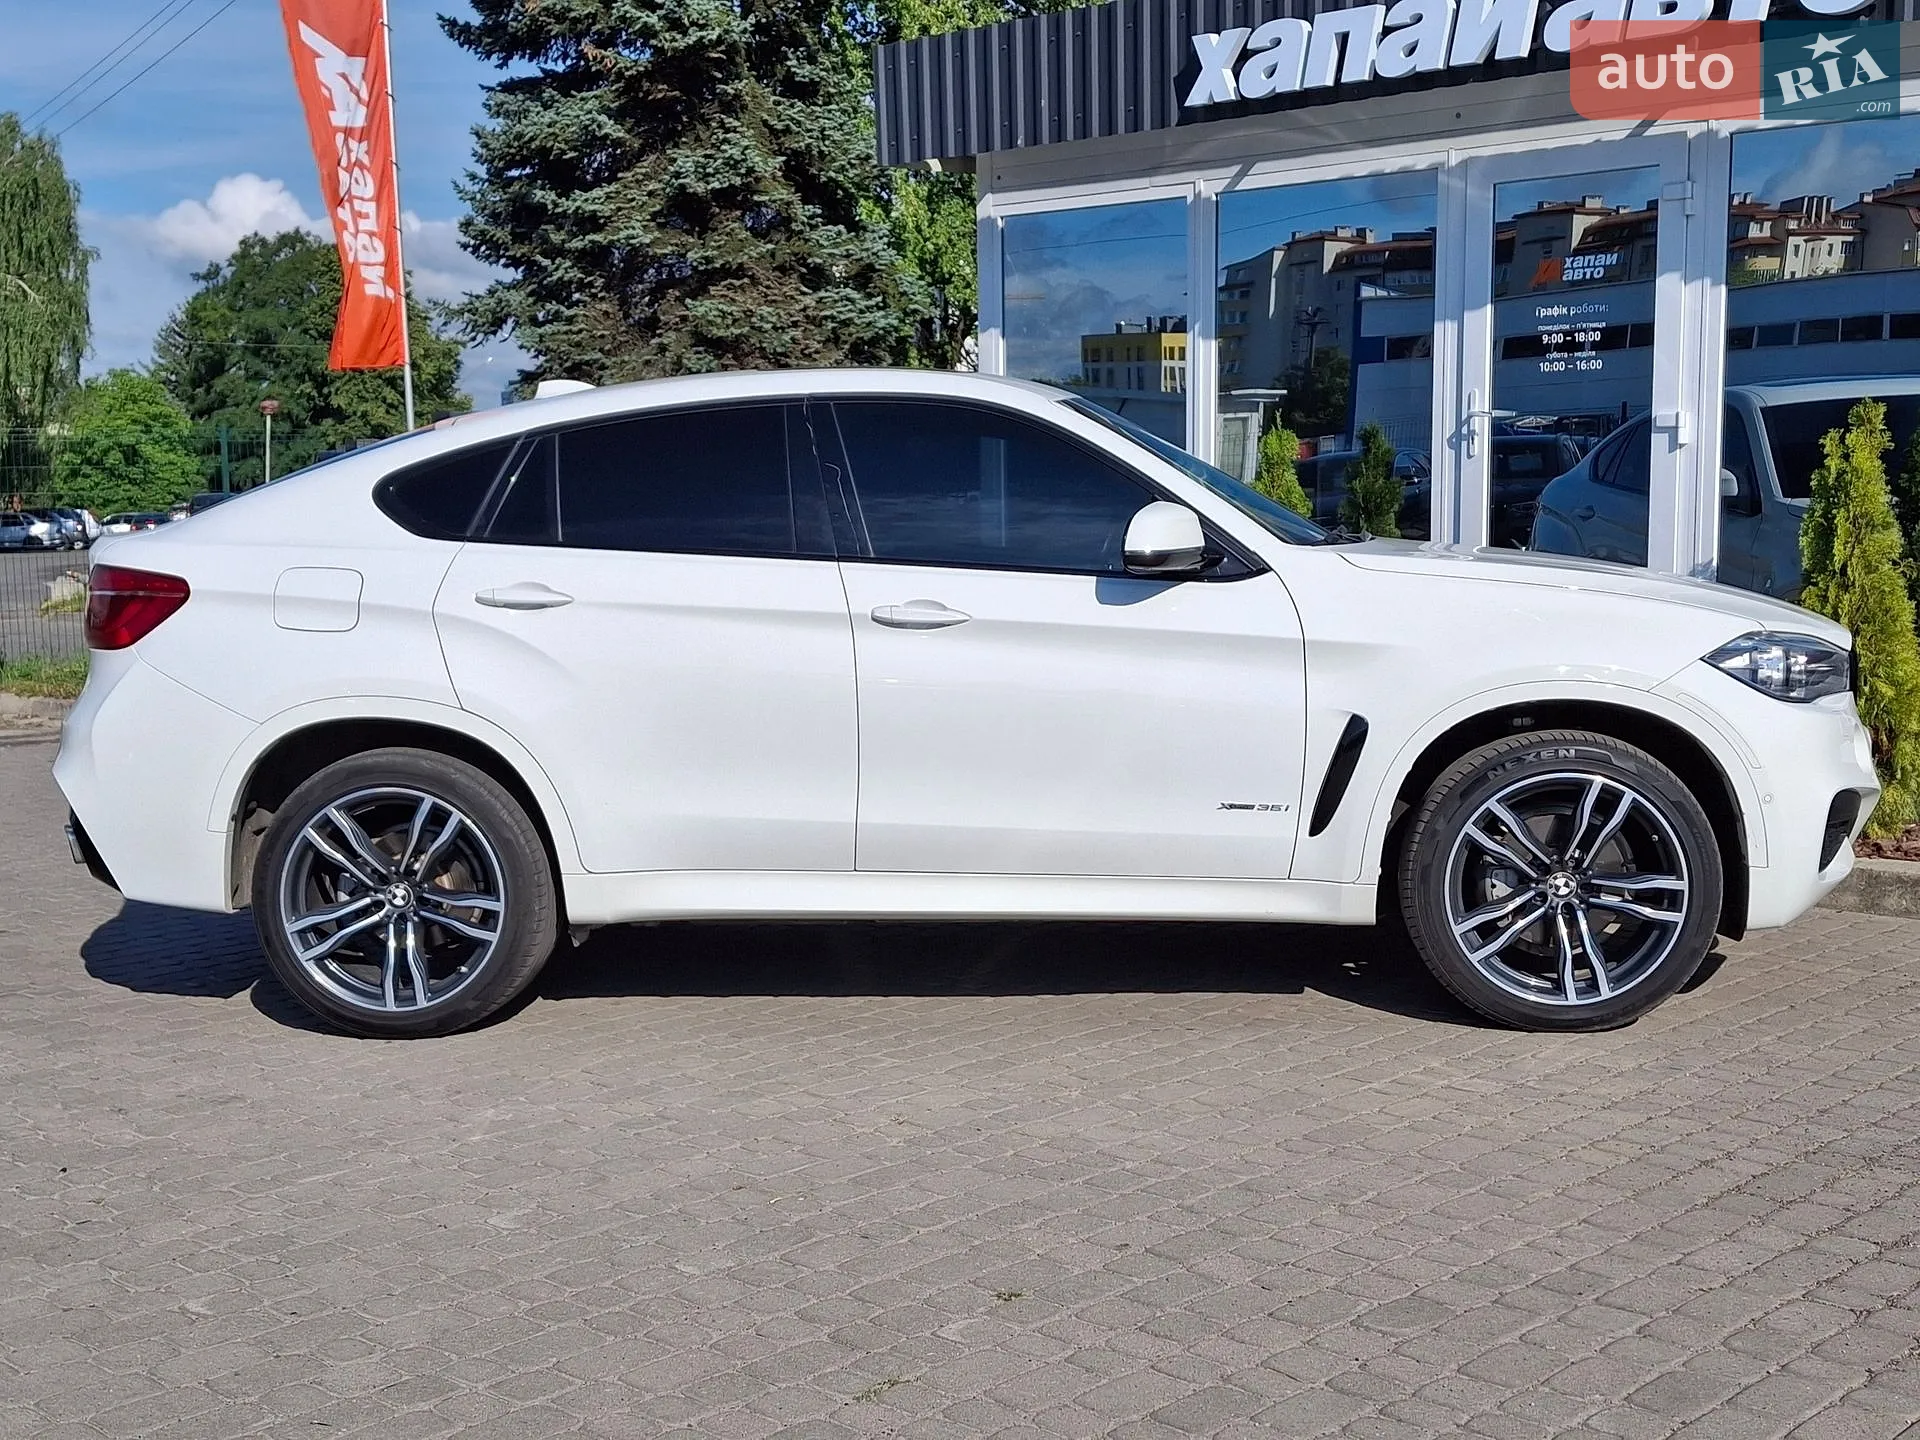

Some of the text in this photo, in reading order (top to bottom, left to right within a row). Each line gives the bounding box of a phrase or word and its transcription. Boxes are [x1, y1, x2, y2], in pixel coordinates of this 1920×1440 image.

[1562, 266, 1605, 281] авто
[1570, 303, 1609, 317] роботи:
[1542, 332, 1564, 344] 9:00
[1574, 331, 1601, 342] 18:00
[1539, 361, 1566, 372] 10:00
[1575, 359, 1603, 371] 16:00
[1487, 748, 1576, 780] NEXEN
